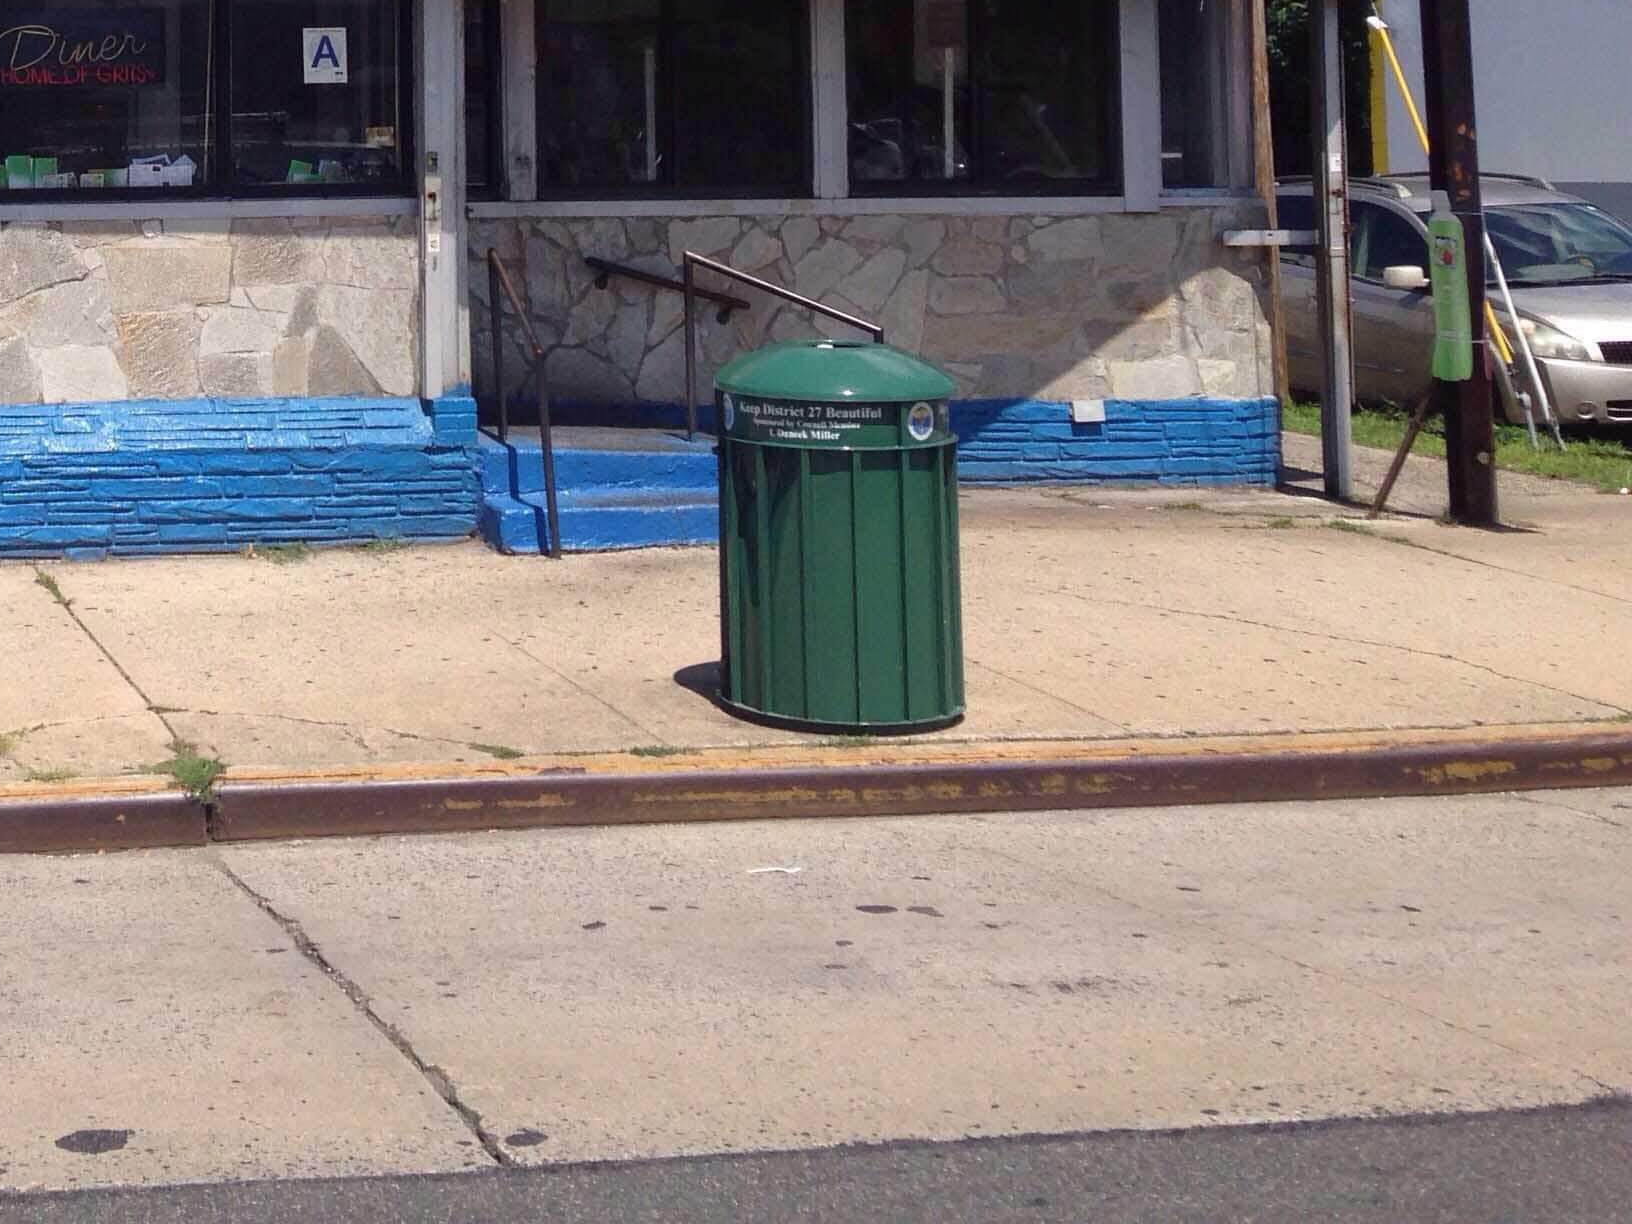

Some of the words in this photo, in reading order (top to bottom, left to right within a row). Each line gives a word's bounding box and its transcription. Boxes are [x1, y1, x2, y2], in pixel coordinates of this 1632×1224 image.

[311, 35, 340, 68] A
[739, 400, 761, 417] Keep
[763, 402, 805, 418] District
[807, 406, 823, 419] 27
[825, 406, 883, 420] Beautiful
[810, 430, 841, 441] Miller
